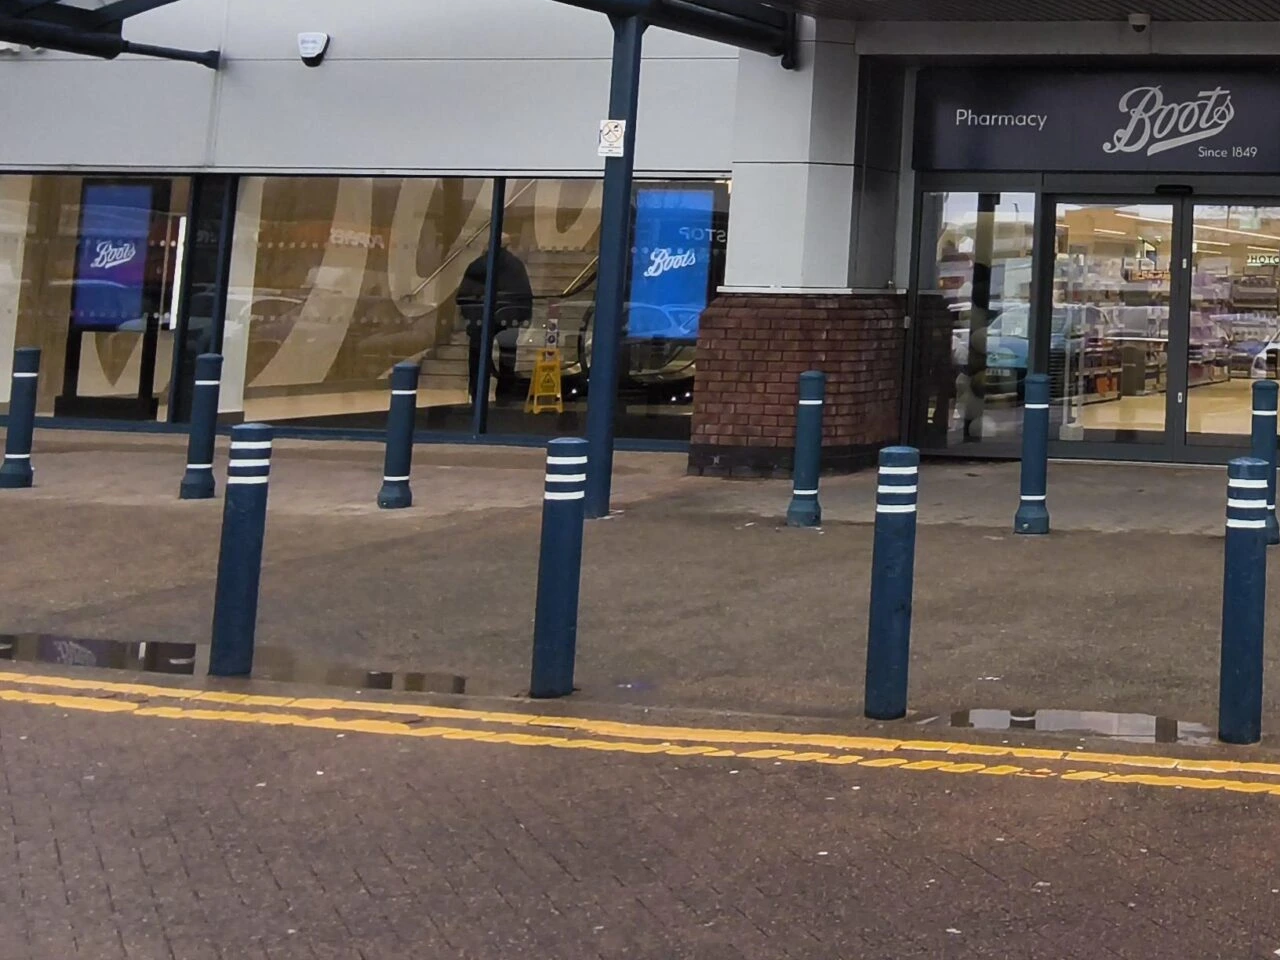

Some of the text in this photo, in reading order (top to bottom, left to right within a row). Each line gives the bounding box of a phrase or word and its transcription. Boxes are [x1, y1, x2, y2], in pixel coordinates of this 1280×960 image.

[955, 109, 1048, 132] Pharmacy
[1102, 85, 1235, 156] Boots
[1198, 146, 1258, 158] Since 1849
[90, 240, 137, 270] Boots
[643, 248, 696, 277] Boots
